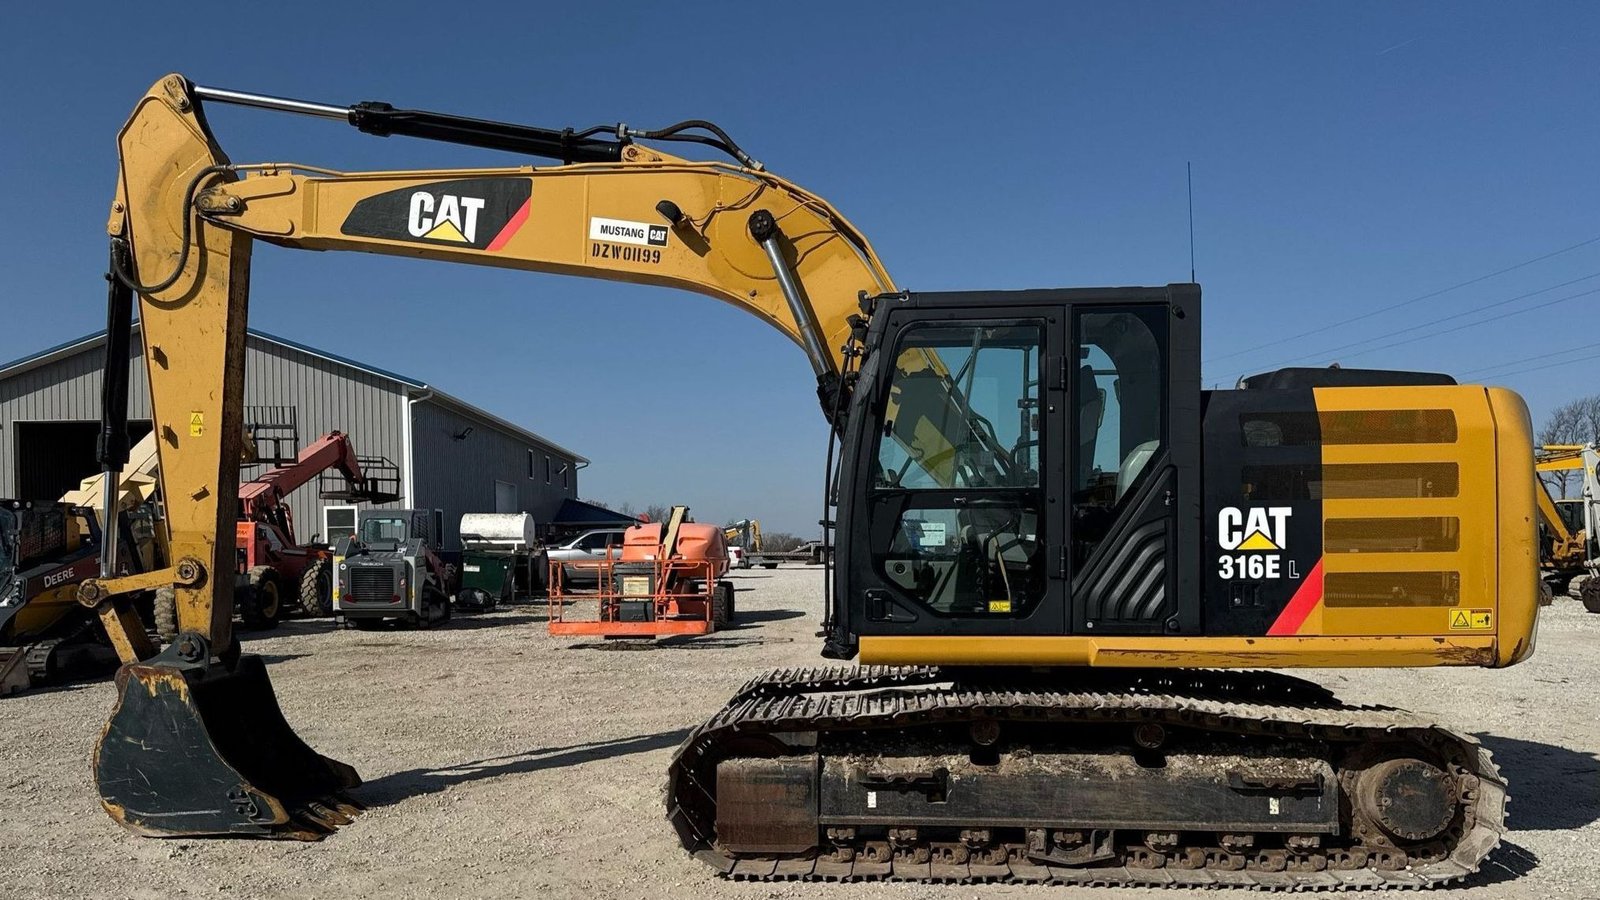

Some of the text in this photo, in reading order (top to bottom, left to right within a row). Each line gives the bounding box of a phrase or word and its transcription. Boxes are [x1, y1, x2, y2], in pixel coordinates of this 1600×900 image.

[408, 191, 485, 244] CAT
[600, 225, 667, 241] MUSTANG CAT
[592, 243, 661, 264] DZW01199
[1218, 506, 1293, 550] CAT
[43, 567, 75, 588] DEERE
[1218, 554, 1300, 579] 316E L
